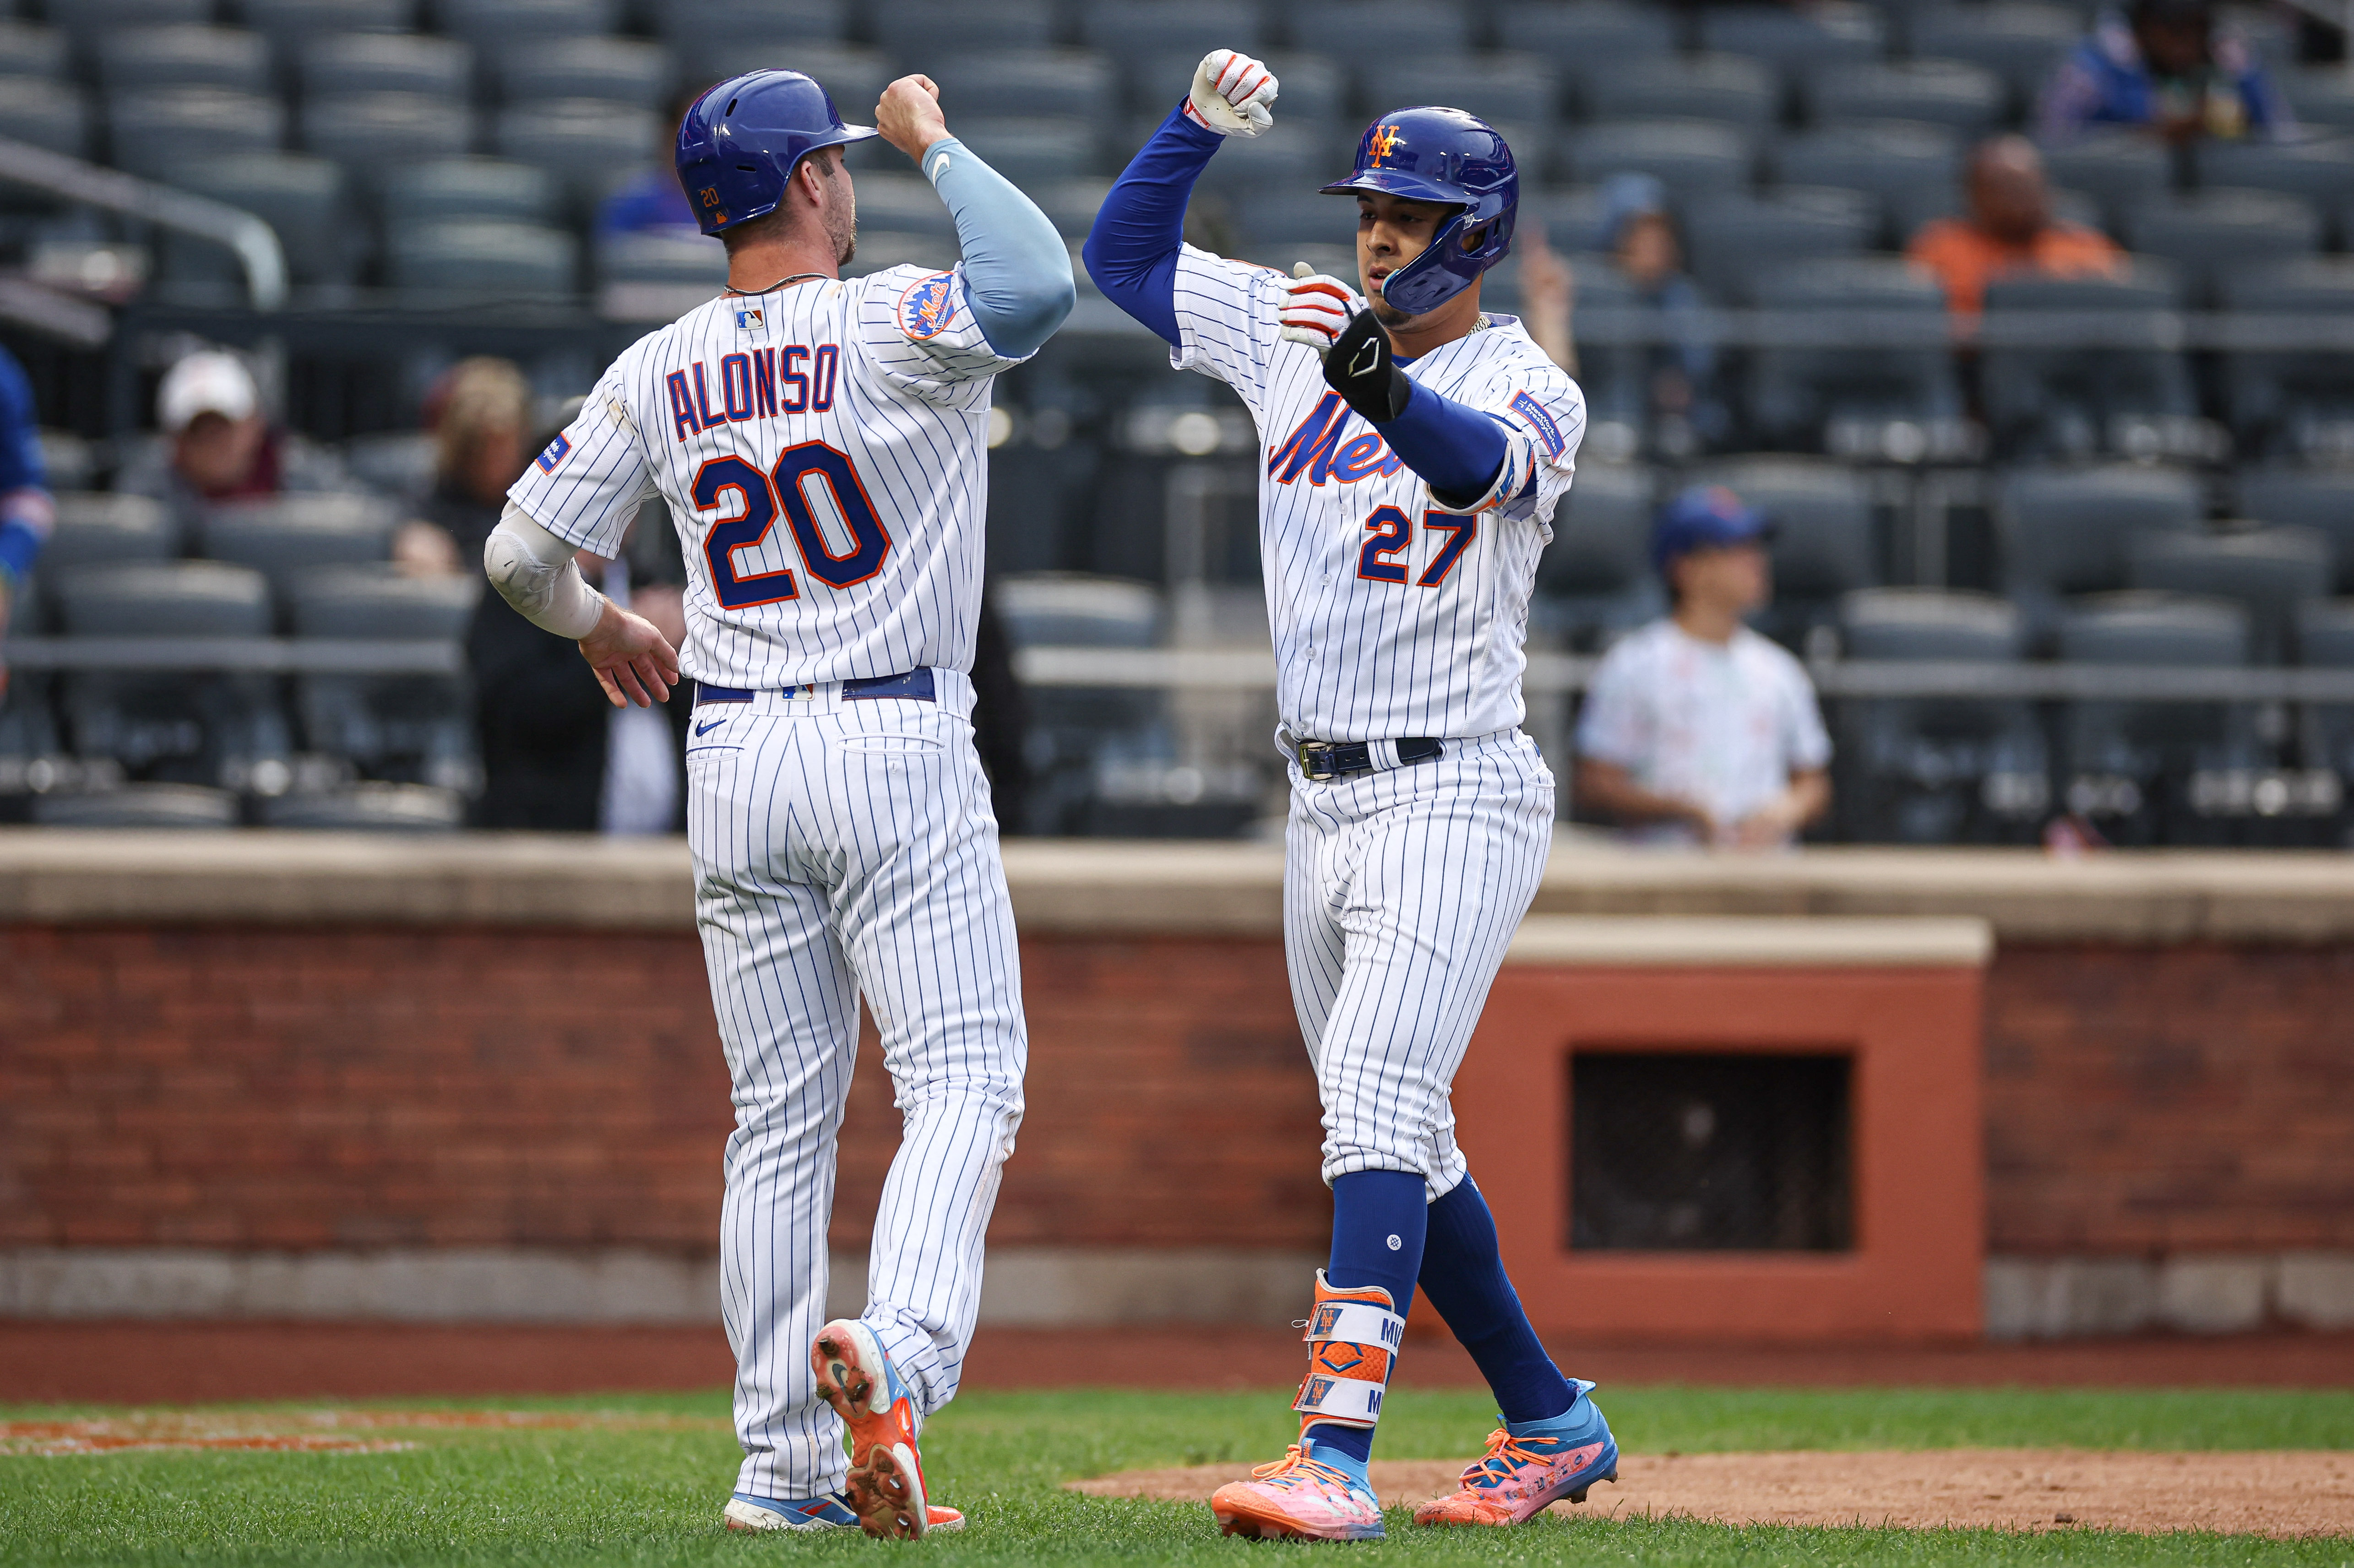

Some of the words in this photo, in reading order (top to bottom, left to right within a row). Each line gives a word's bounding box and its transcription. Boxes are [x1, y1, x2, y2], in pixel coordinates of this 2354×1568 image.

[701, 188, 719, 207] 20
[919, 282, 950, 329] Mets
[666, 344, 839, 443] ALONSO
[1268, 391, 1411, 487] Me
[1524, 407, 1558, 453] Presbyterian
[690, 439, 892, 611] 20
[1357, 505, 1477, 587] 27
[1381, 1317, 1404, 1348] MV
